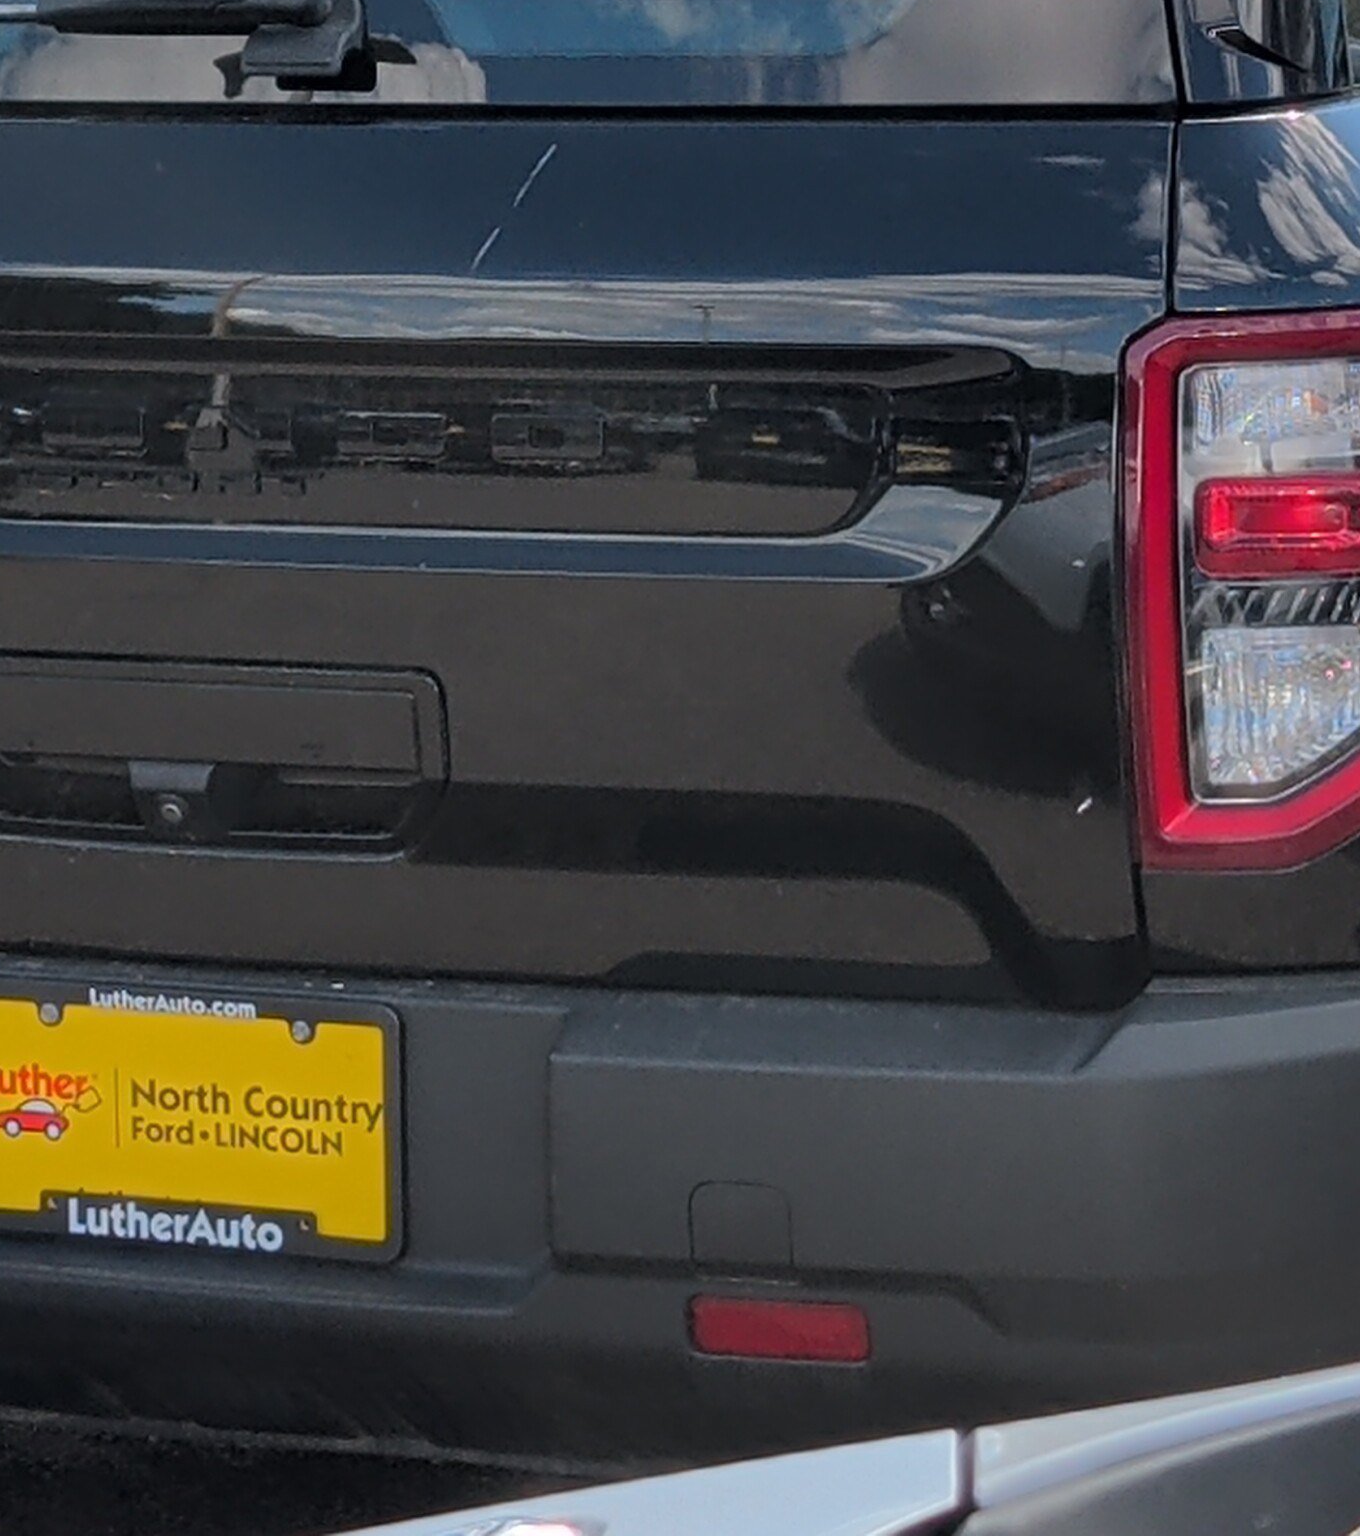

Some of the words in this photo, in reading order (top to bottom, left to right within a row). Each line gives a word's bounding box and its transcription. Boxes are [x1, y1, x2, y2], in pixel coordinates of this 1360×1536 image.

[88, 987, 257, 1020] LutherAuto.com
[130, 1078, 231, 1115] North
[243, 1085, 384, 1132] Country
[131, 1117, 194, 1146] Ford
[215, 1125, 344, 1157] LINCOLN
[67, 1197, 284, 1251] LutherAuto
